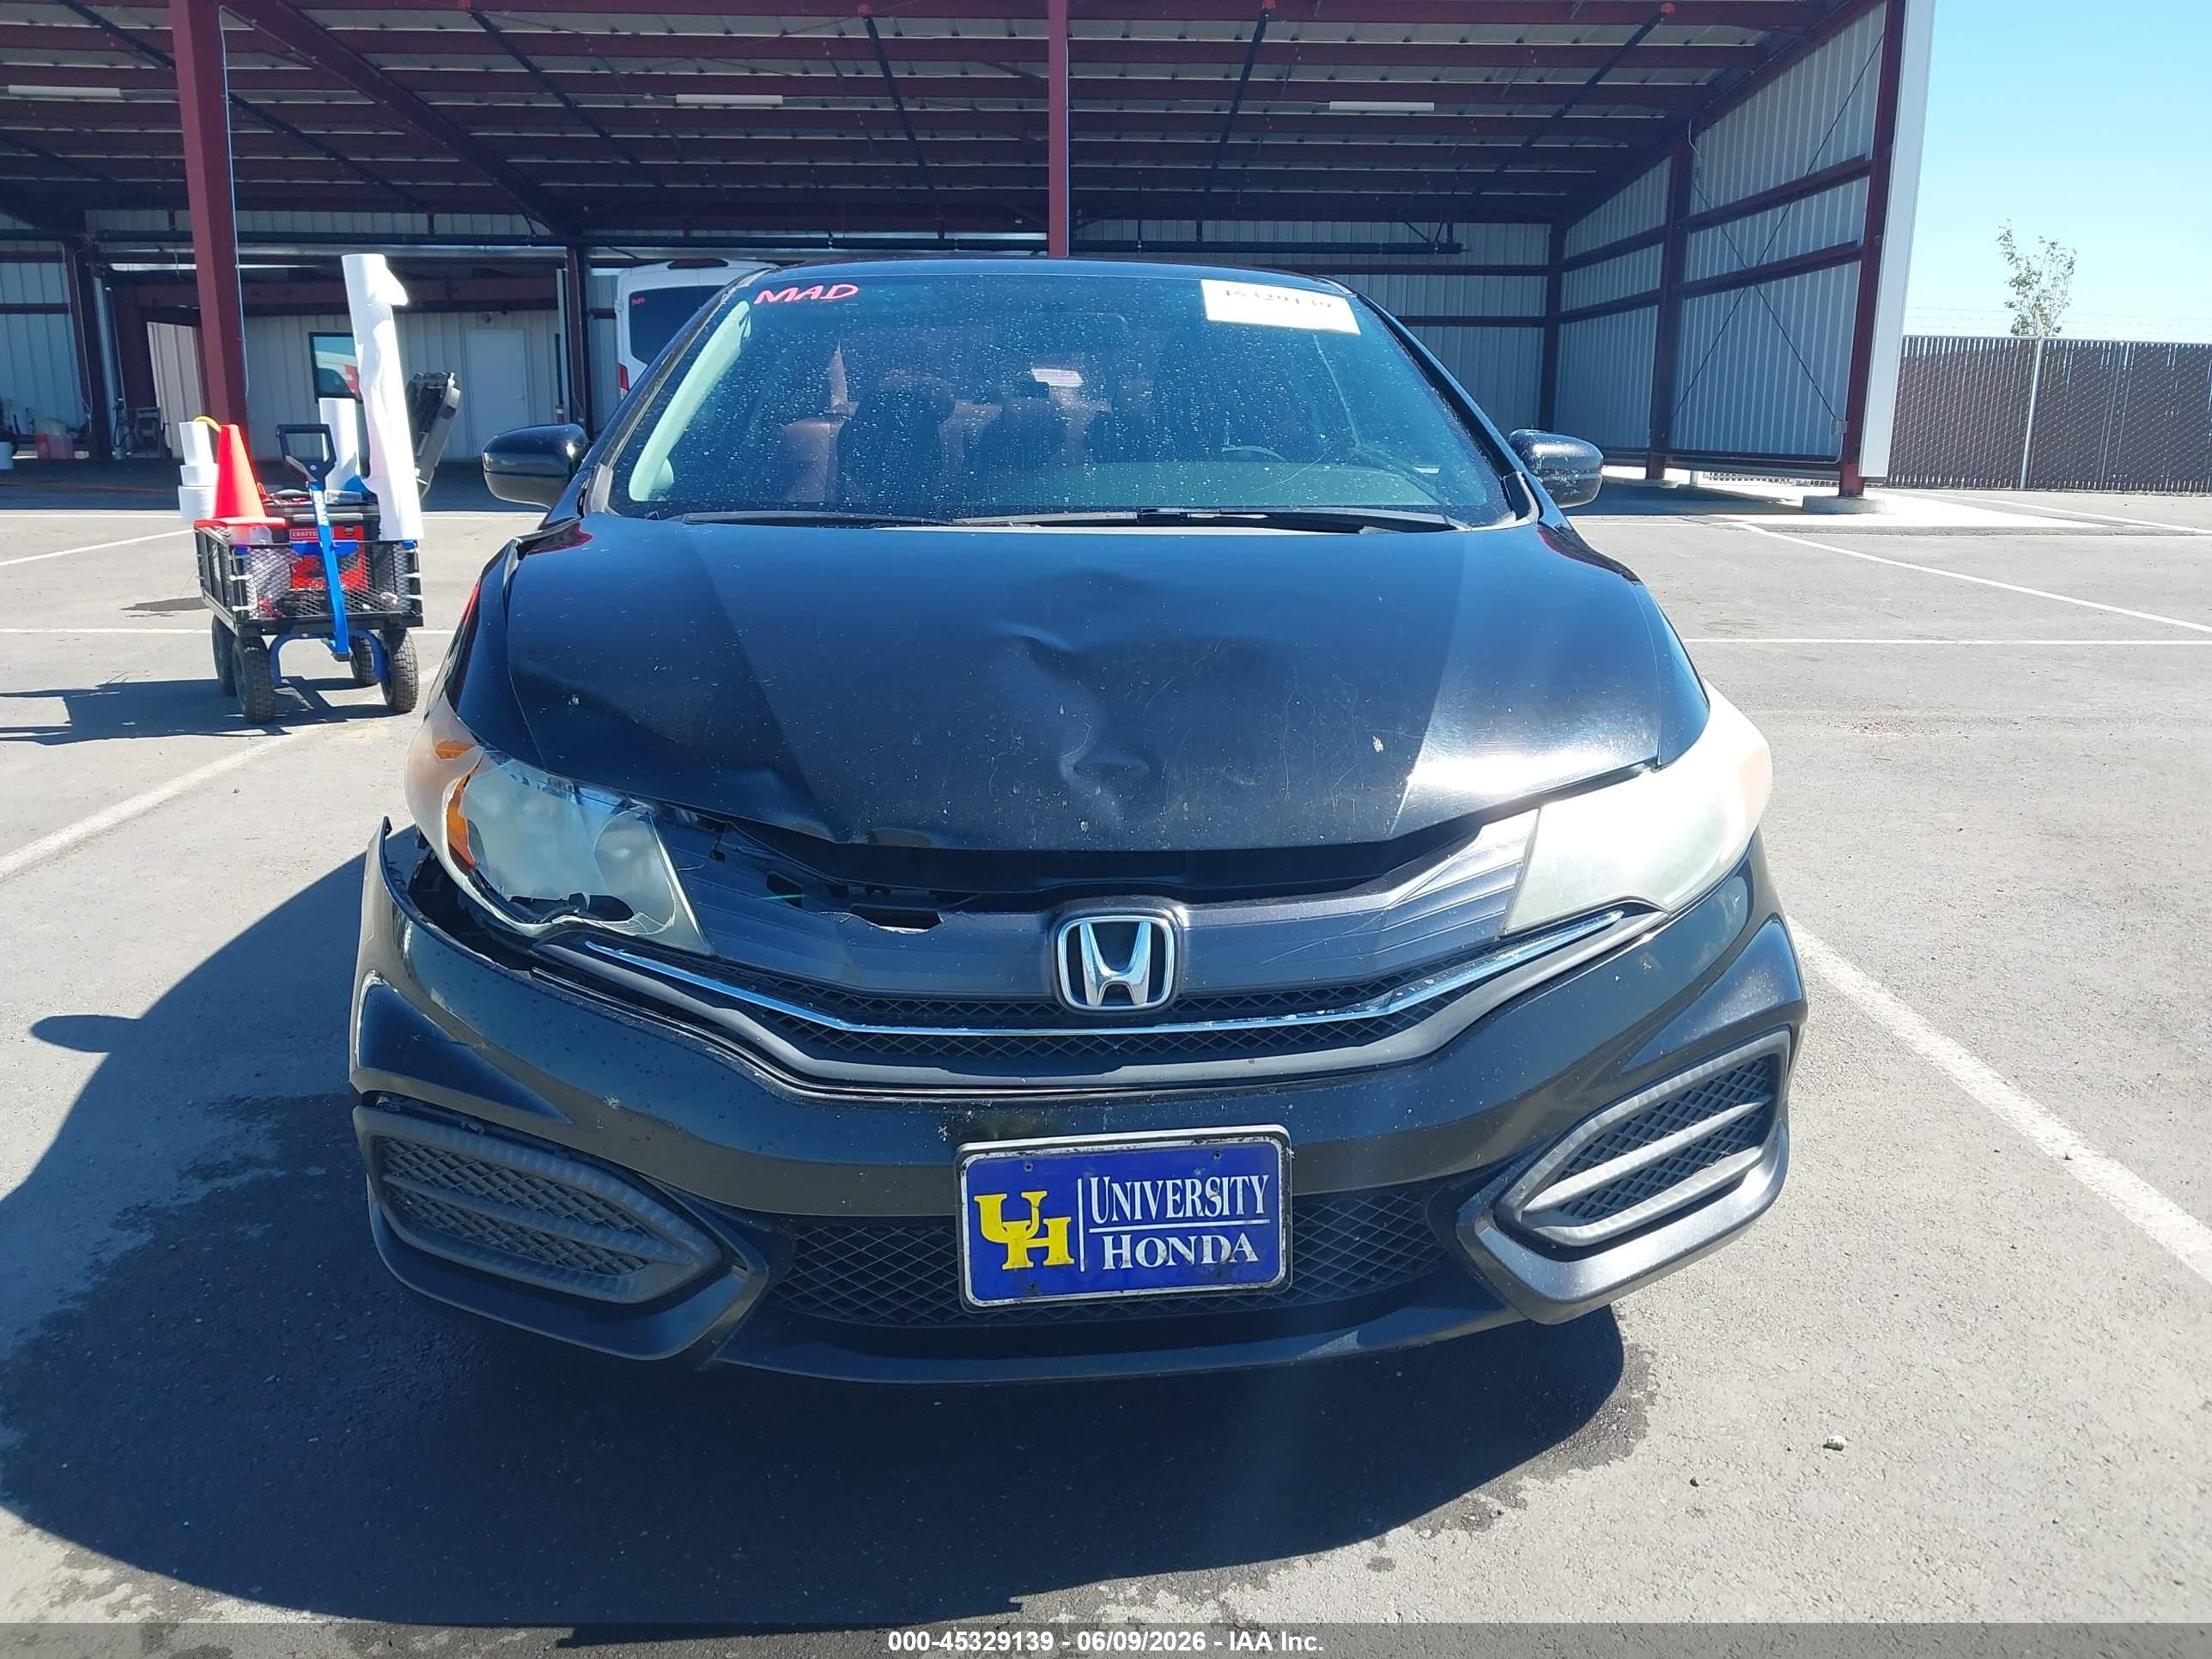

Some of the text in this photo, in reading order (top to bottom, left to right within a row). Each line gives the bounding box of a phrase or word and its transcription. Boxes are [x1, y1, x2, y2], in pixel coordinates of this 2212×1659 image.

[754, 284, 859, 305] MAD
[1089, 1174, 1270, 1224] UNIVERSITY
[1103, 1232, 1260, 1270] HONDA
